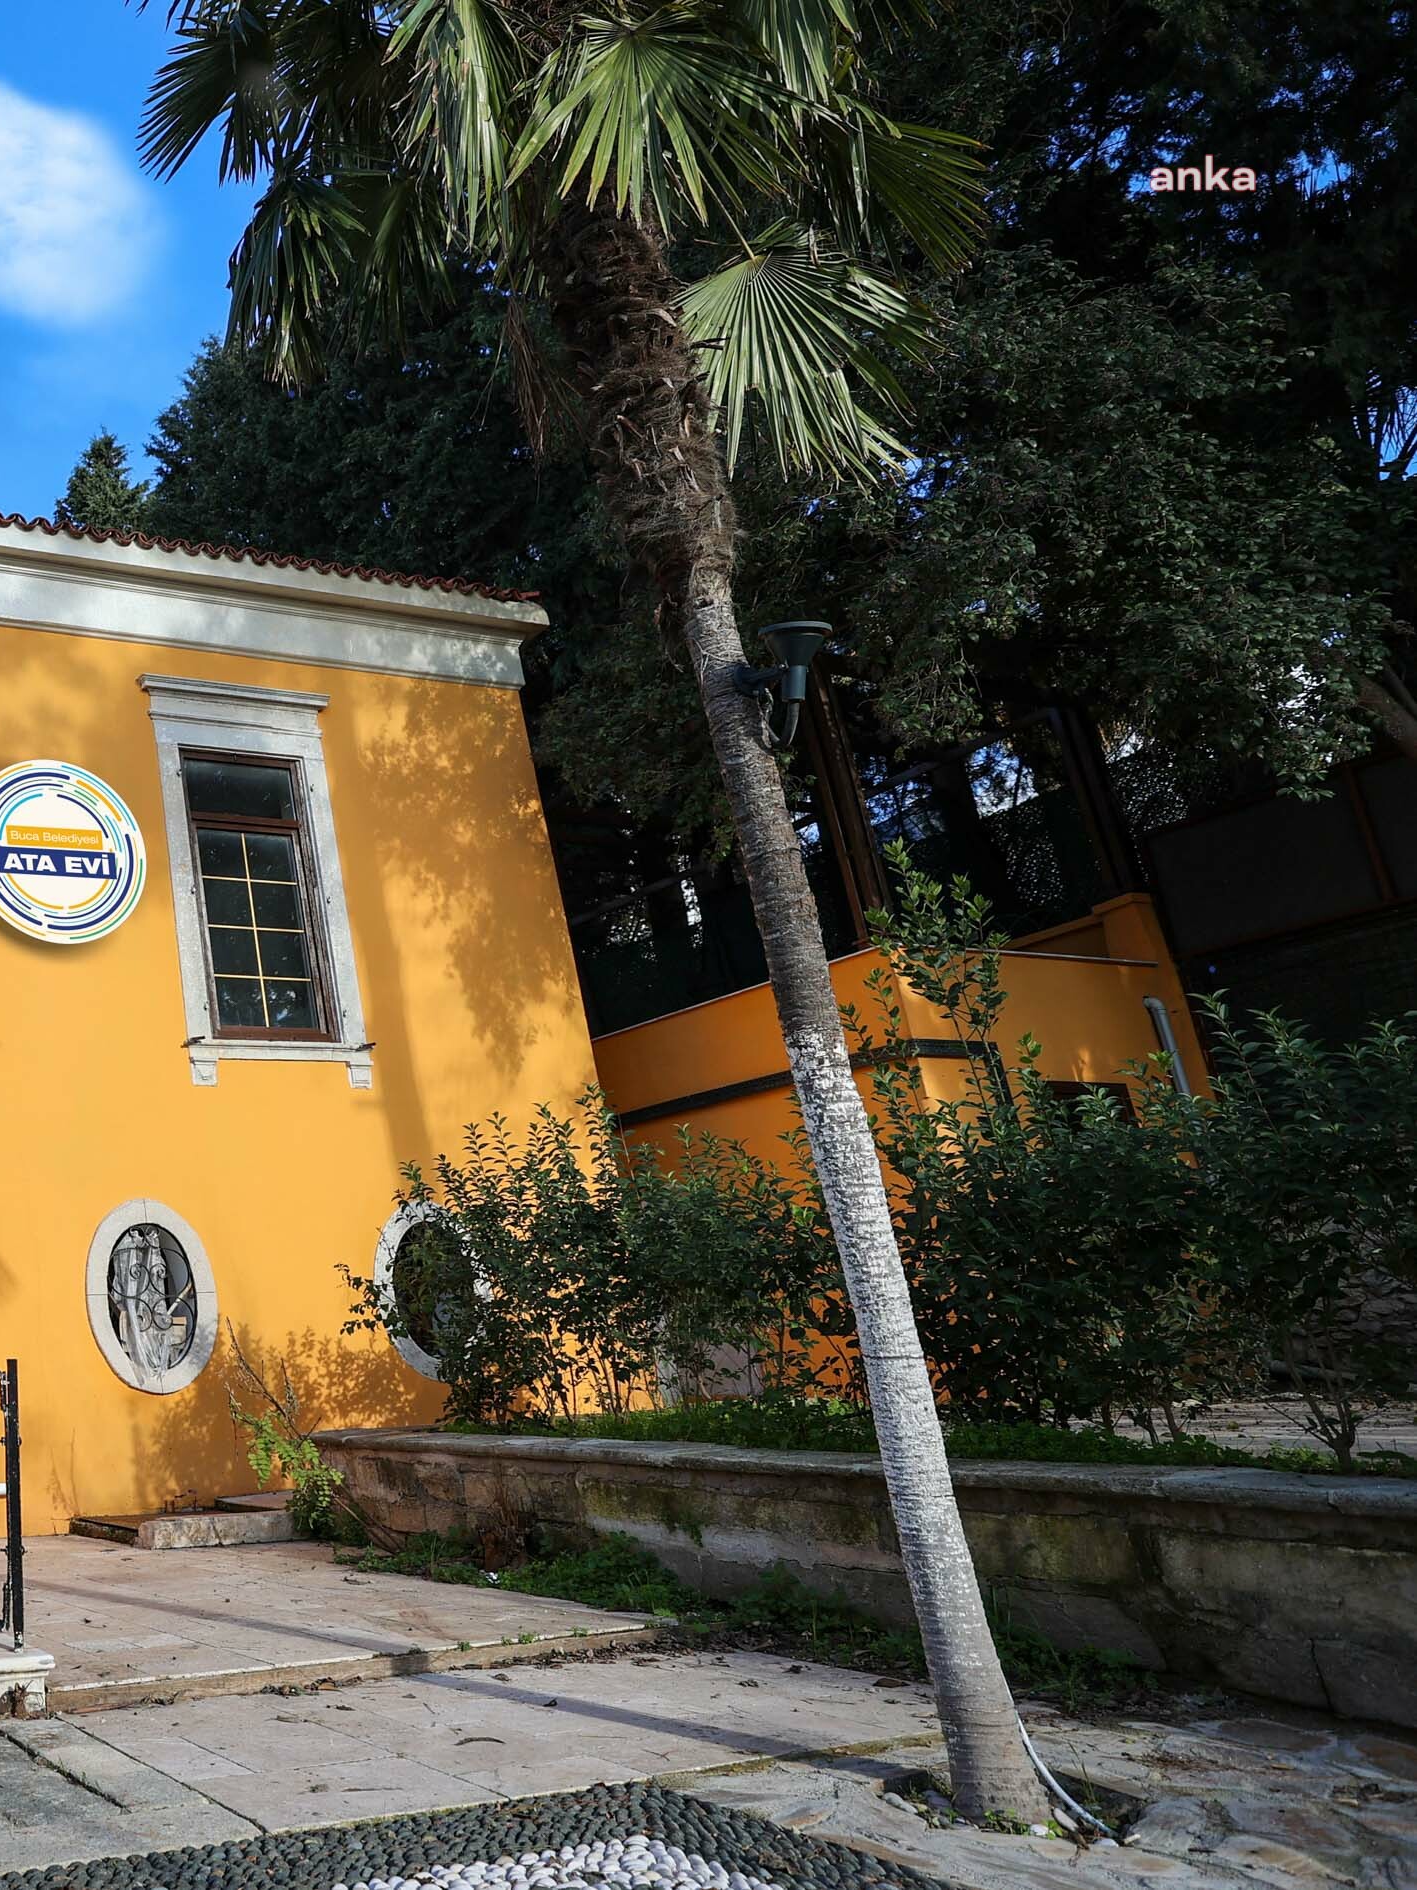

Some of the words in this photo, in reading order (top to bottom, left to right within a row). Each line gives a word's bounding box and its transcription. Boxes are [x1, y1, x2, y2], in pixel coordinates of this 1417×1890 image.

[10, 830, 40, 841] Buca
[42, 831, 99, 845] Belediyesi
[4, 853, 57, 872] ATA
[65, 854, 110, 875] EVİ
